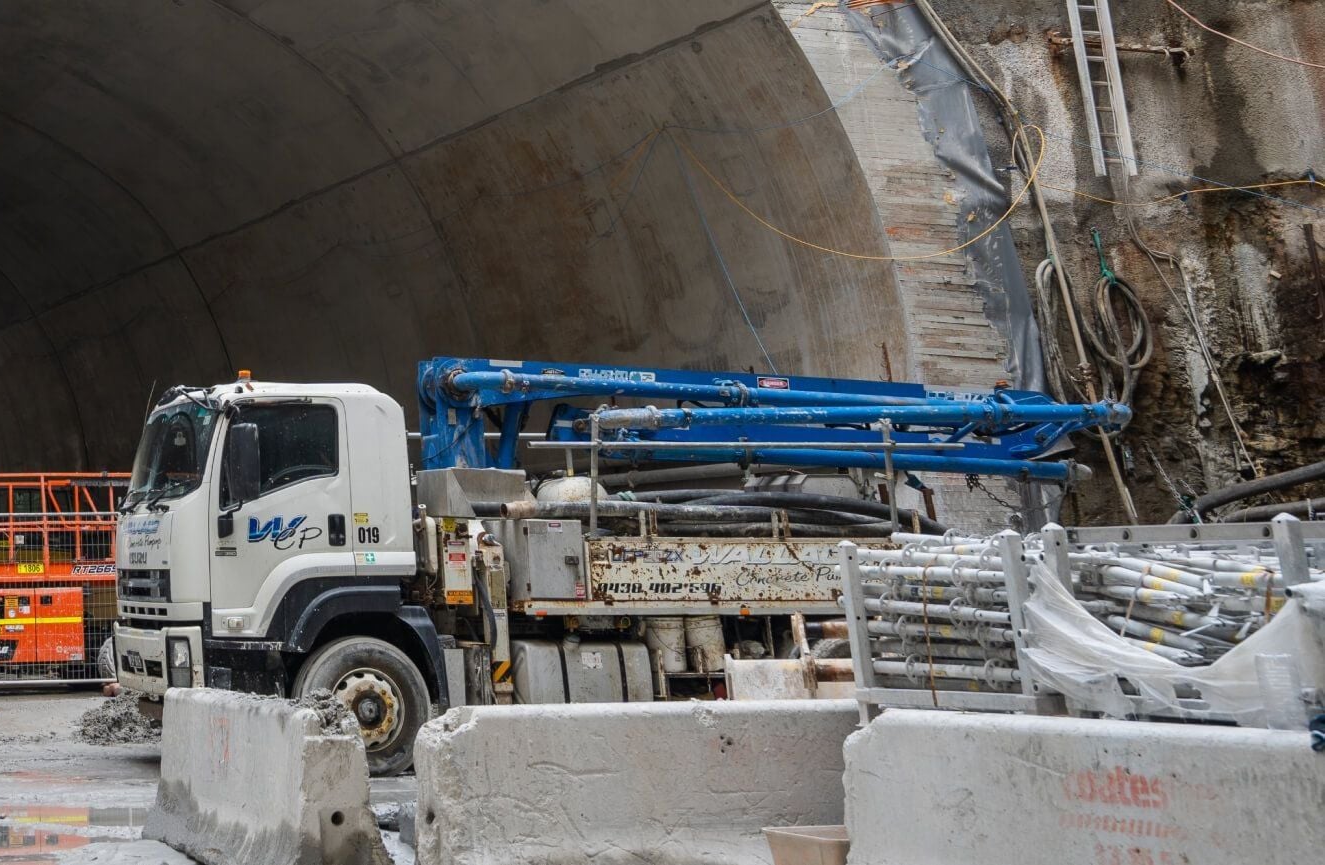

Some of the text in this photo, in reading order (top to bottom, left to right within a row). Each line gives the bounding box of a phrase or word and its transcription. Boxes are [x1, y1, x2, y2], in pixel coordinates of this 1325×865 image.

[359, 527, 379, 544] 019
[736, 569, 809, 586] Concrete
[649, 582, 683, 594] 402
